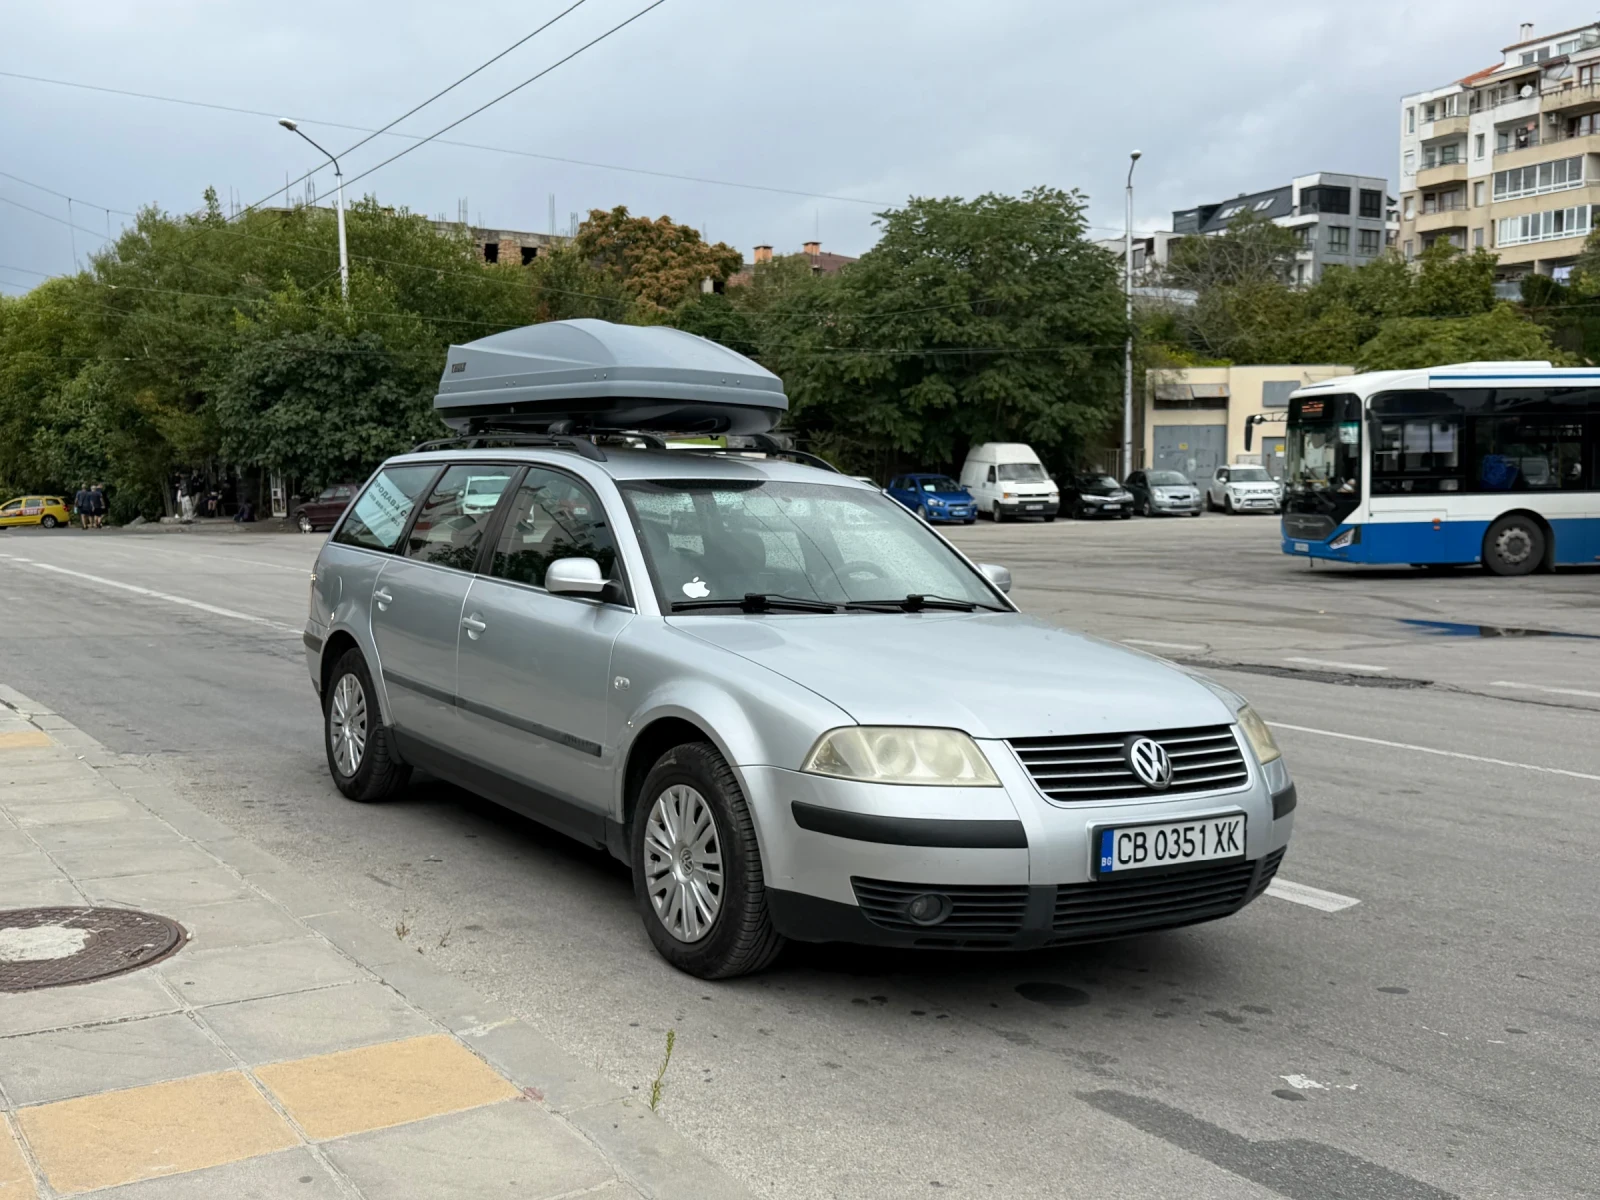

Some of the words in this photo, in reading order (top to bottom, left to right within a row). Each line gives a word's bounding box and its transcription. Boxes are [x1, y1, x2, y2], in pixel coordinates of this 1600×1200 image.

[1117, 832, 1148, 865] CB
[1154, 825, 1206, 861] 0351
[1213, 820, 1240, 854] XK
[1101, 857, 1112, 867] BG
